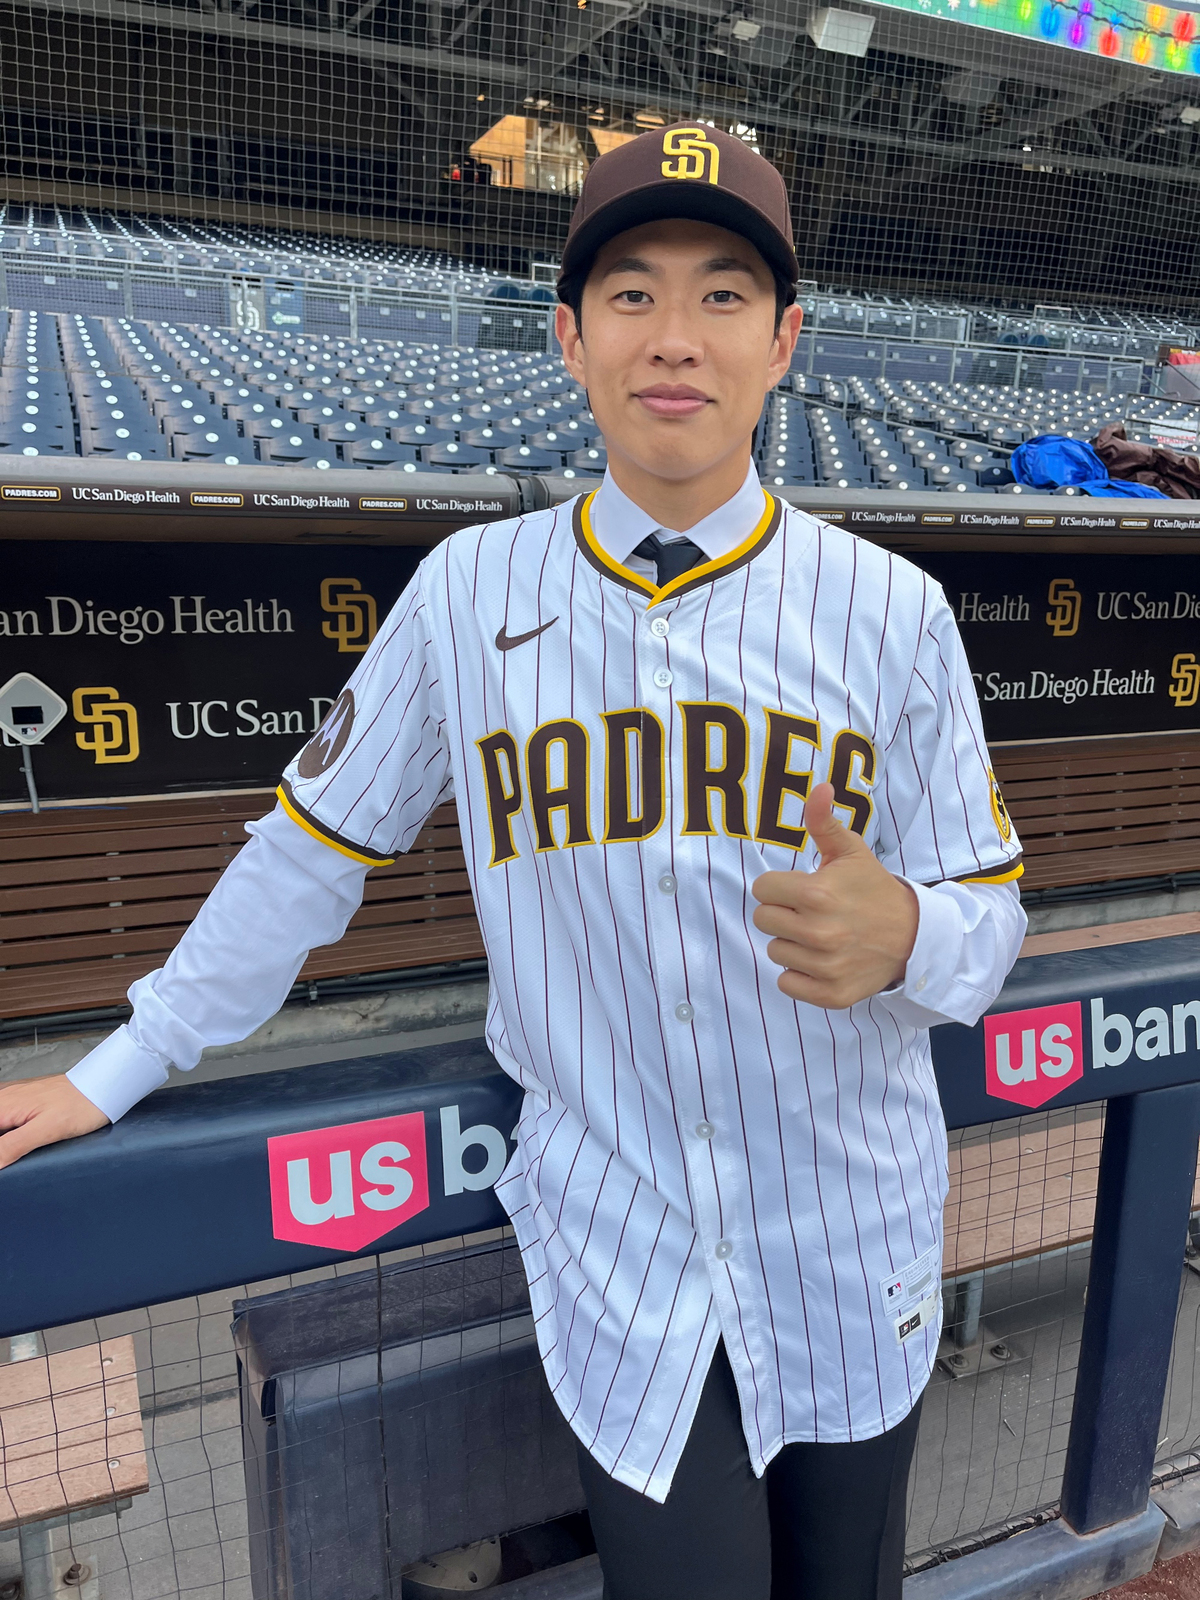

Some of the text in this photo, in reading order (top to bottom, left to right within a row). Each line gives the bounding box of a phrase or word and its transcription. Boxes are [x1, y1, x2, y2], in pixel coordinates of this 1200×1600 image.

[4, 489, 57, 498] PADRES.COM
[71, 487, 180, 504] UC San Diego Health
[194, 495, 241, 504] PADRES.COM
[253, 494, 350, 509] UC San Diego Health
[362, 500, 404, 508] PADRES.COM
[416, 499, 503, 513] UC San Diego Health
[851, 511, 916, 524] UC San Diego Health
[960, 514, 971, 524] UC
[970, 515, 983, 525] San
[982, 515, 1001, 526] Diego
[957, 592, 1030, 622] Health
[1097, 592, 1130, 620] UC
[1131, 592, 1169, 619] San
[45, 596, 164, 645] Diego
[169, 596, 295, 634] Health
[984, 672, 1025, 701] San
[1028, 671, 1089, 704] Diego
[1090, 669, 1155, 696] Health
[166, 700, 229, 739] UC
[235, 699, 305, 737] San
[474, 700, 876, 869] PADRES
[995, 1022, 1074, 1086] us
[287, 1141, 415, 1226] us
